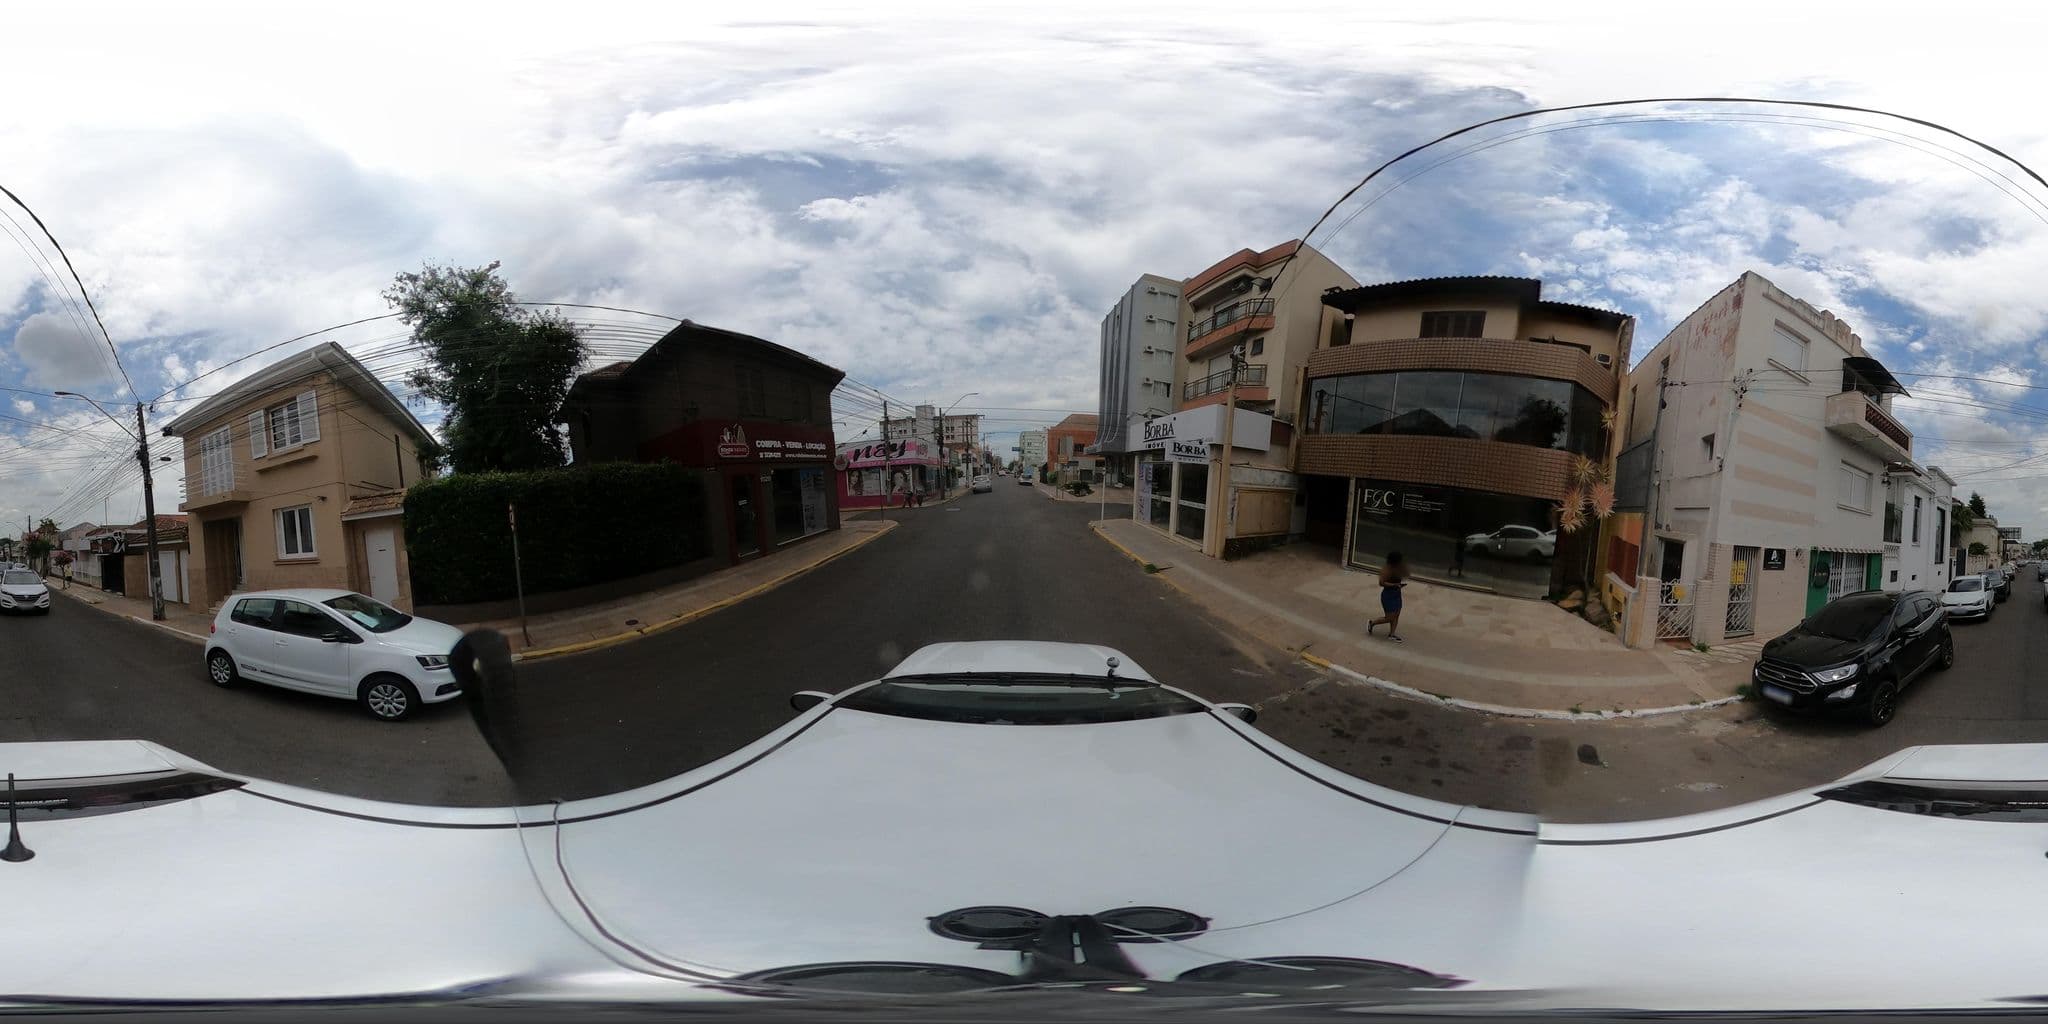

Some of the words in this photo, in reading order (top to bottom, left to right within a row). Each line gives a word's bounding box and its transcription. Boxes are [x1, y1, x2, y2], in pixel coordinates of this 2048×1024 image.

[1144, 422, 1175, 440] BORBA
[755, 440, 781, 448] COMPRA
[785, 441, 803, 449] VENDA
[1173, 442, 1206, 456] BORBA
